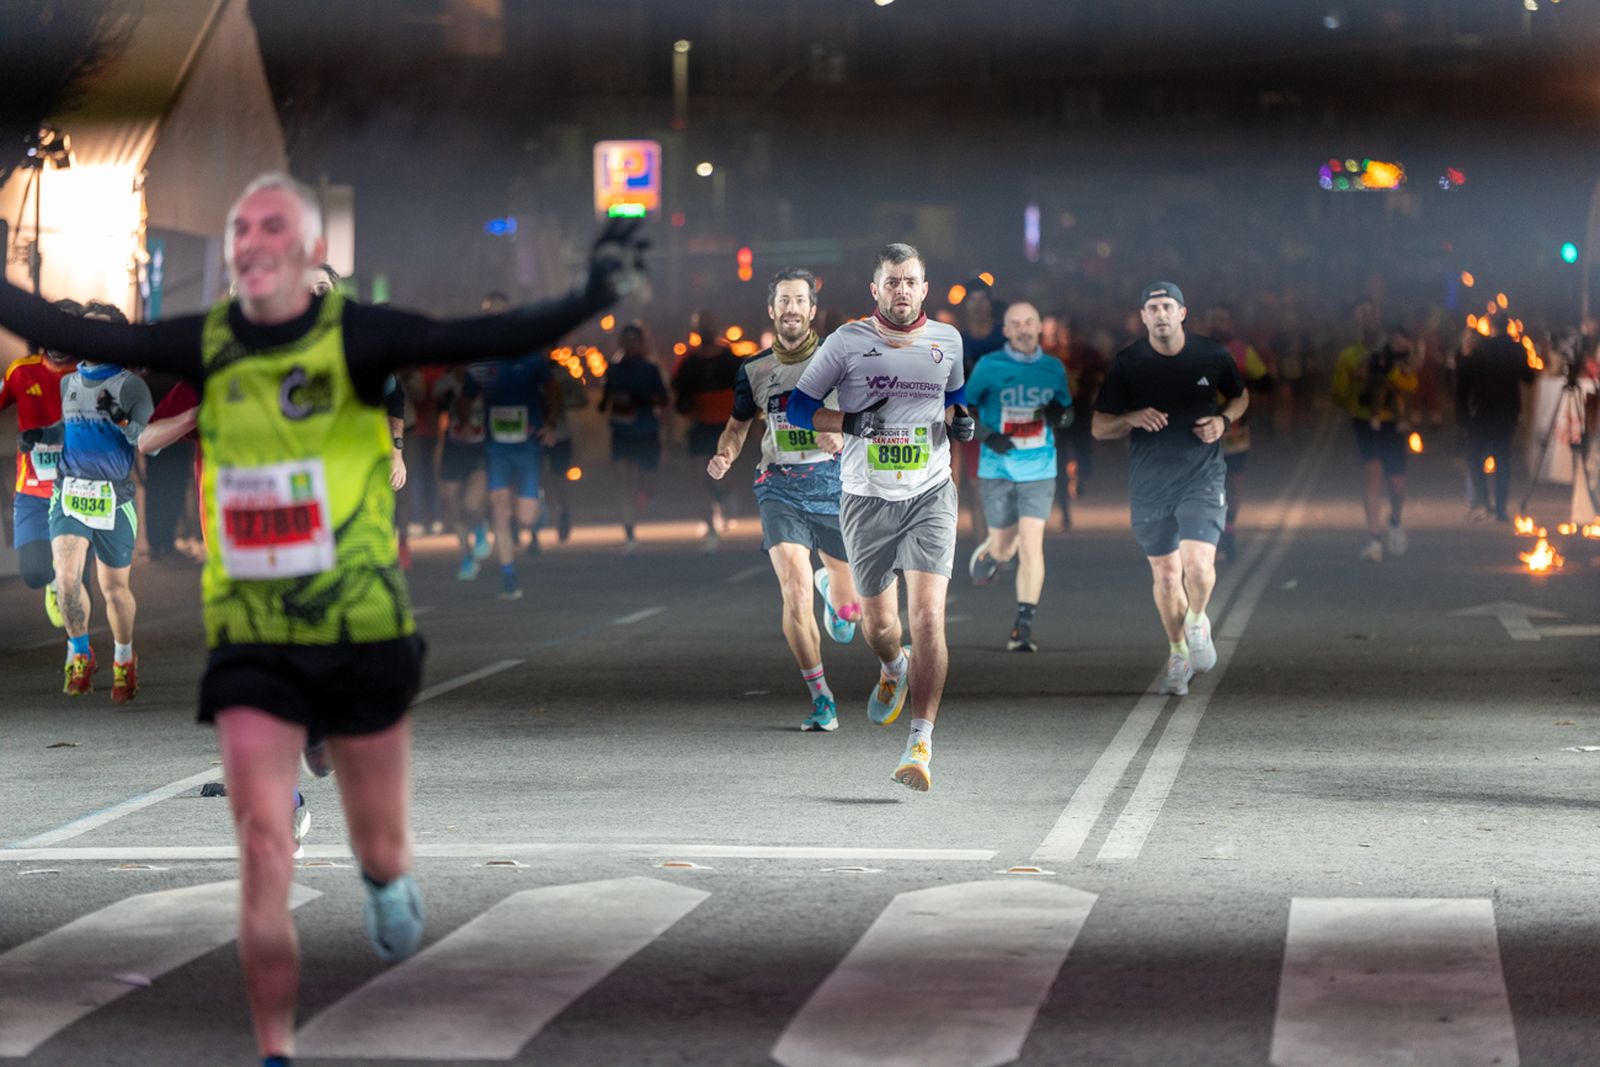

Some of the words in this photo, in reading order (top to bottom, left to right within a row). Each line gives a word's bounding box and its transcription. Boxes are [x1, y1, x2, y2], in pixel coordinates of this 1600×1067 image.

[607, 146, 646, 190] P
[879, 445, 922, 464] 8907
[72, 496, 105, 512] 8934
